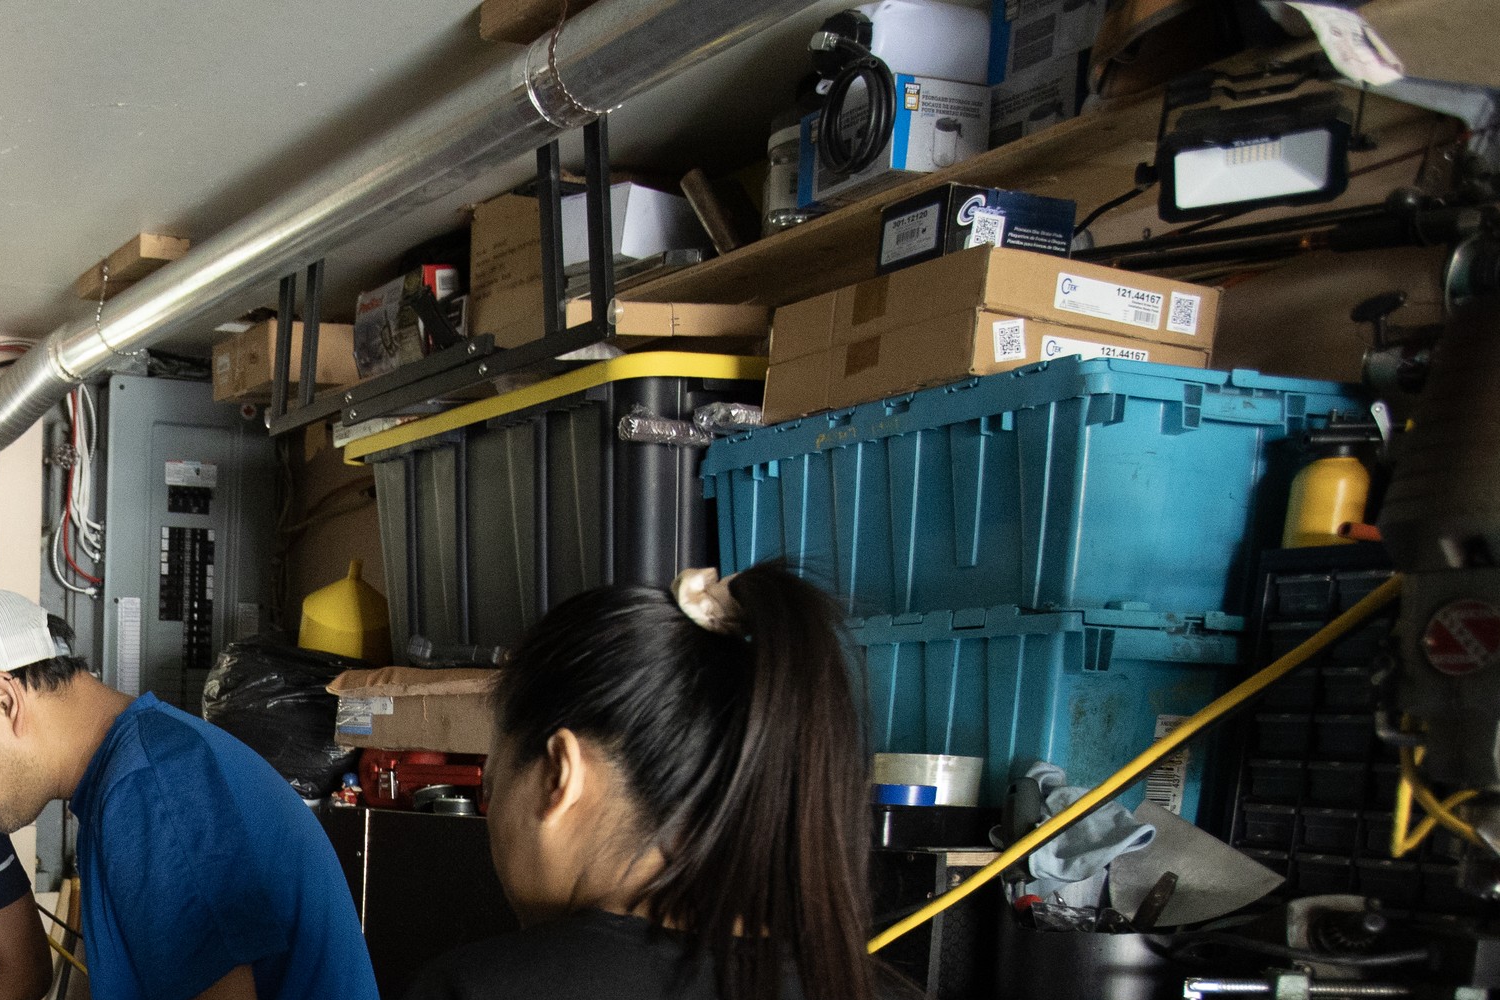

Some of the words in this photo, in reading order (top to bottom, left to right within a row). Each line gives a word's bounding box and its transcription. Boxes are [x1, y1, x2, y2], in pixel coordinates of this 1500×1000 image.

[892, 210, 928, 229] 301.12120
[1116, 287, 1161, 304] 121.44167
[1100, 346, 1146, 361] 121.44167
